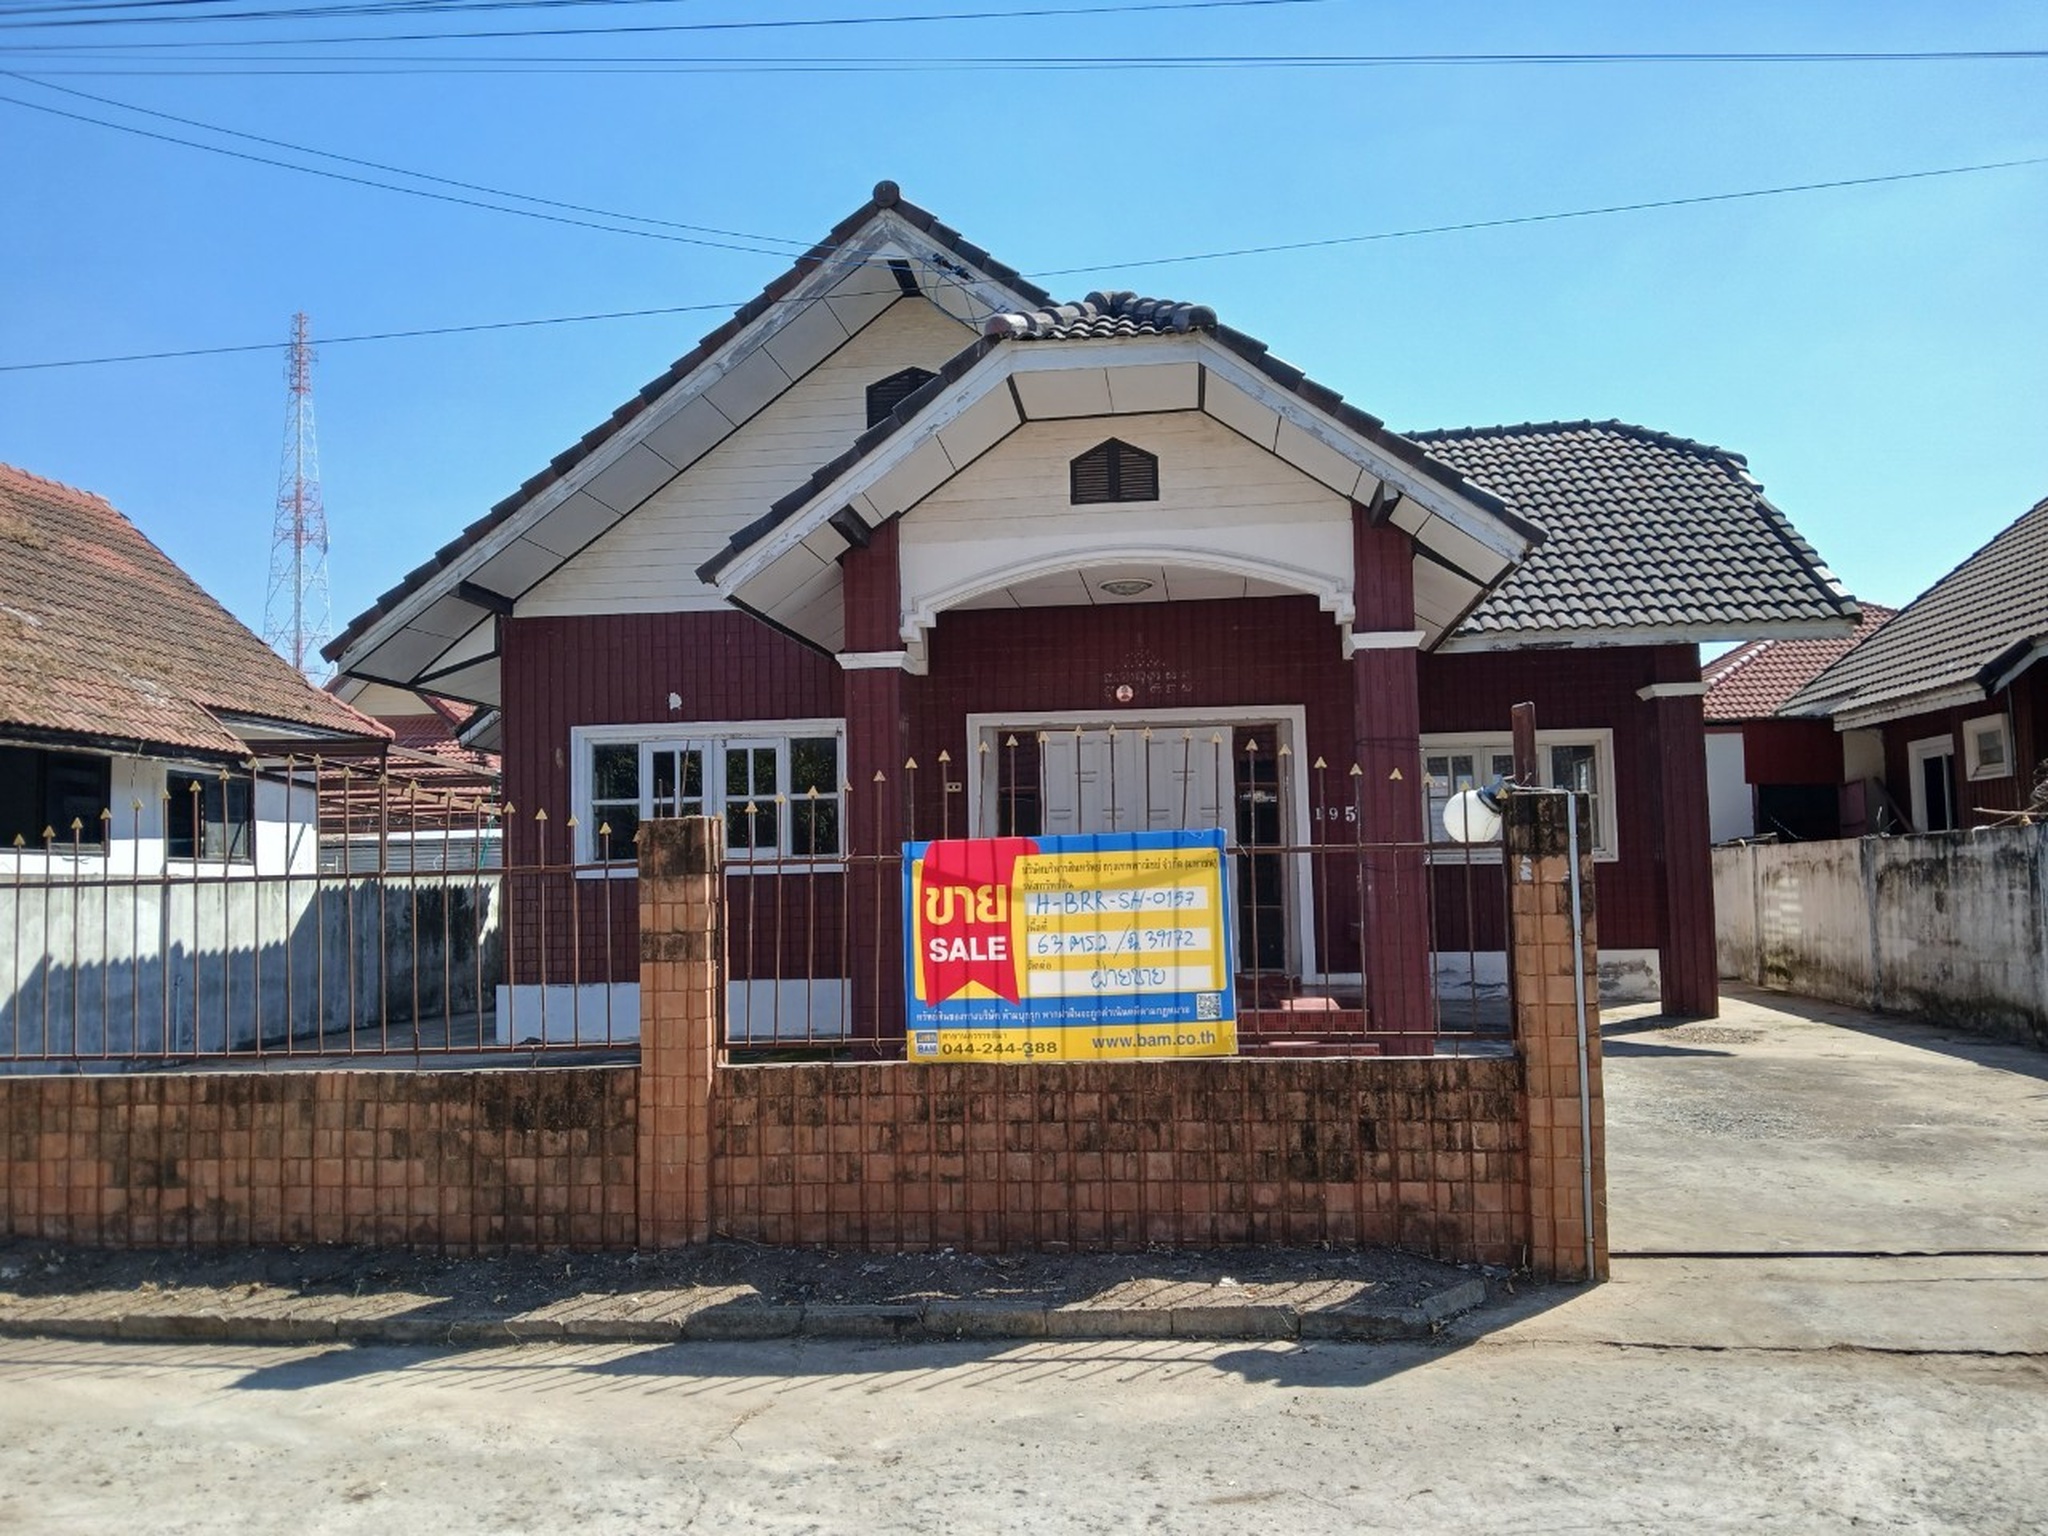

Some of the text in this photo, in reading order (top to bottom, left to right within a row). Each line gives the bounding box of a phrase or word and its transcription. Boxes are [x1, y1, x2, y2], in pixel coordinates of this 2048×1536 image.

[1315, 806, 1356, 822] 195
[925, 884, 1007, 925] ขาย
[928, 936, 1007, 962] SALE
[1038, 934, 1063, 953] 63
[1090, 960, 1166, 989] ฝ่ายขาย
[942, 1041, 1058, 1055] 044-244-388
[1092, 1031, 1216, 1048] www.bam.co.th
